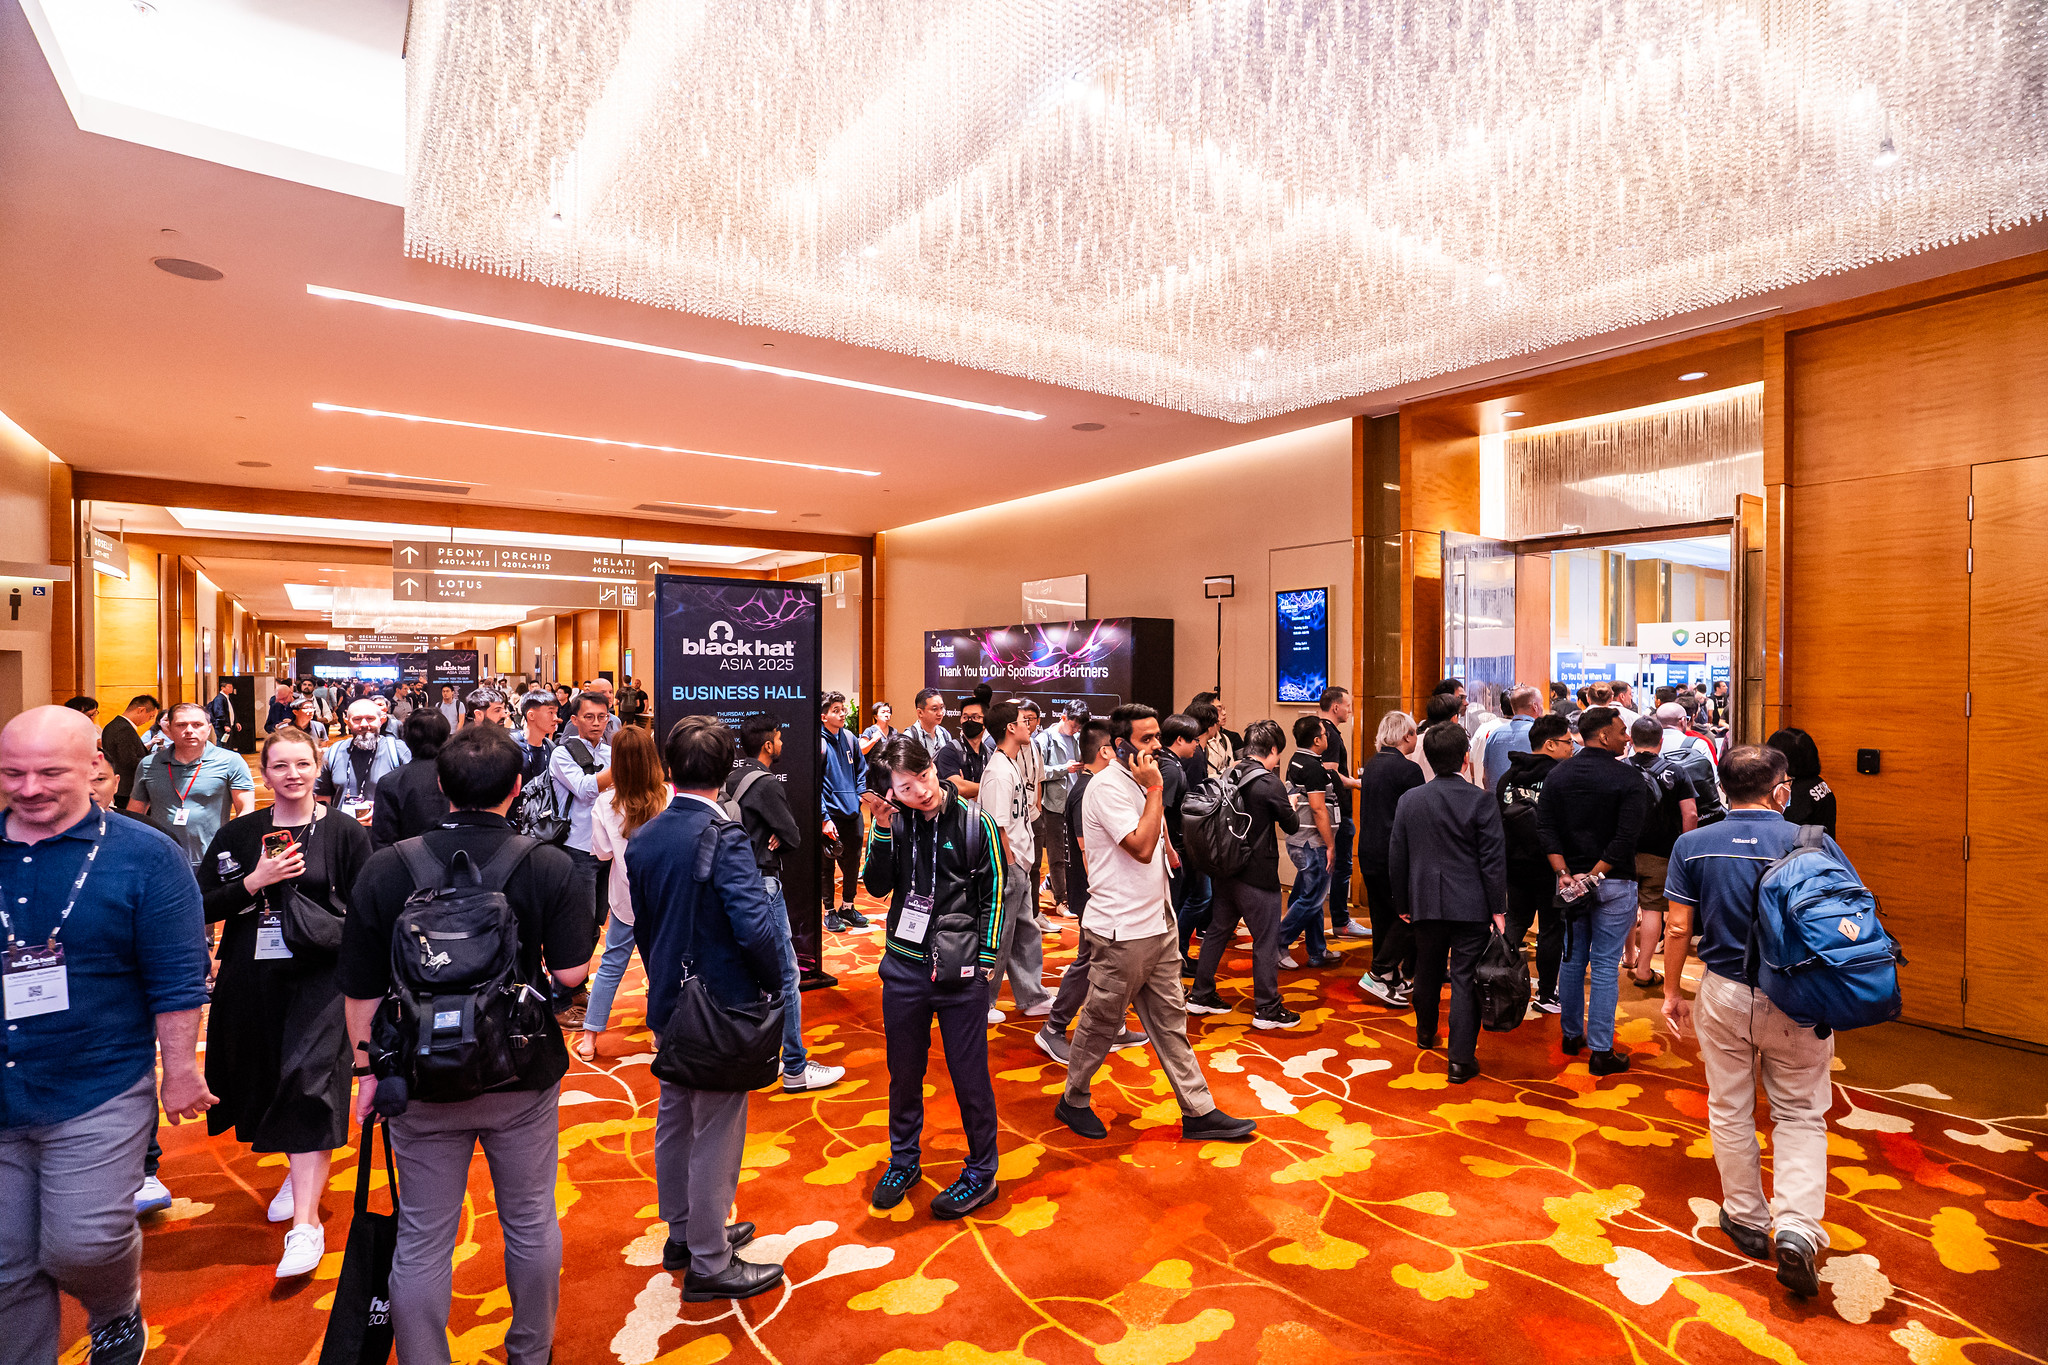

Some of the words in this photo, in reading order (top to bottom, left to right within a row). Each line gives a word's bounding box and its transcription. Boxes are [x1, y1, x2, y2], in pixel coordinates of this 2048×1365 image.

[438, 548, 484, 558] PEONY
[501, 551, 552, 562] ORCHID
[438, 558, 490, 567] 4401A-4413
[501, 561, 550, 570] 4201A-4312
[593, 557, 635, 567] MELATI
[592, 567, 635, 575] 4001A-4112
[438, 579, 483, 589] LOTUS
[438, 590, 466, 598] 4A-4E
[682, 637, 753, 656] black
[754, 639, 795, 656] hat
[719, 658, 755, 671] ASIA
[758, 658, 794, 671] 2025
[938, 664, 961, 677] Thank
[963, 665, 977, 677] You
[979, 665, 989, 677] to
[990, 664, 1006, 677] Our
[1007, 664, 1051, 680] Sponsors
[1053, 664, 1061, 677] &
[1063, 663, 1109, 678] Partners
[1561, 672, 1568, 680] Do
[1568, 672, 1577, 680] You
[1588, 672, 1602, 680] Where
[1602, 672, 1611, 680] Your
[672, 685, 760, 700] BUSINESS
[764, 685, 806, 699] HALL
